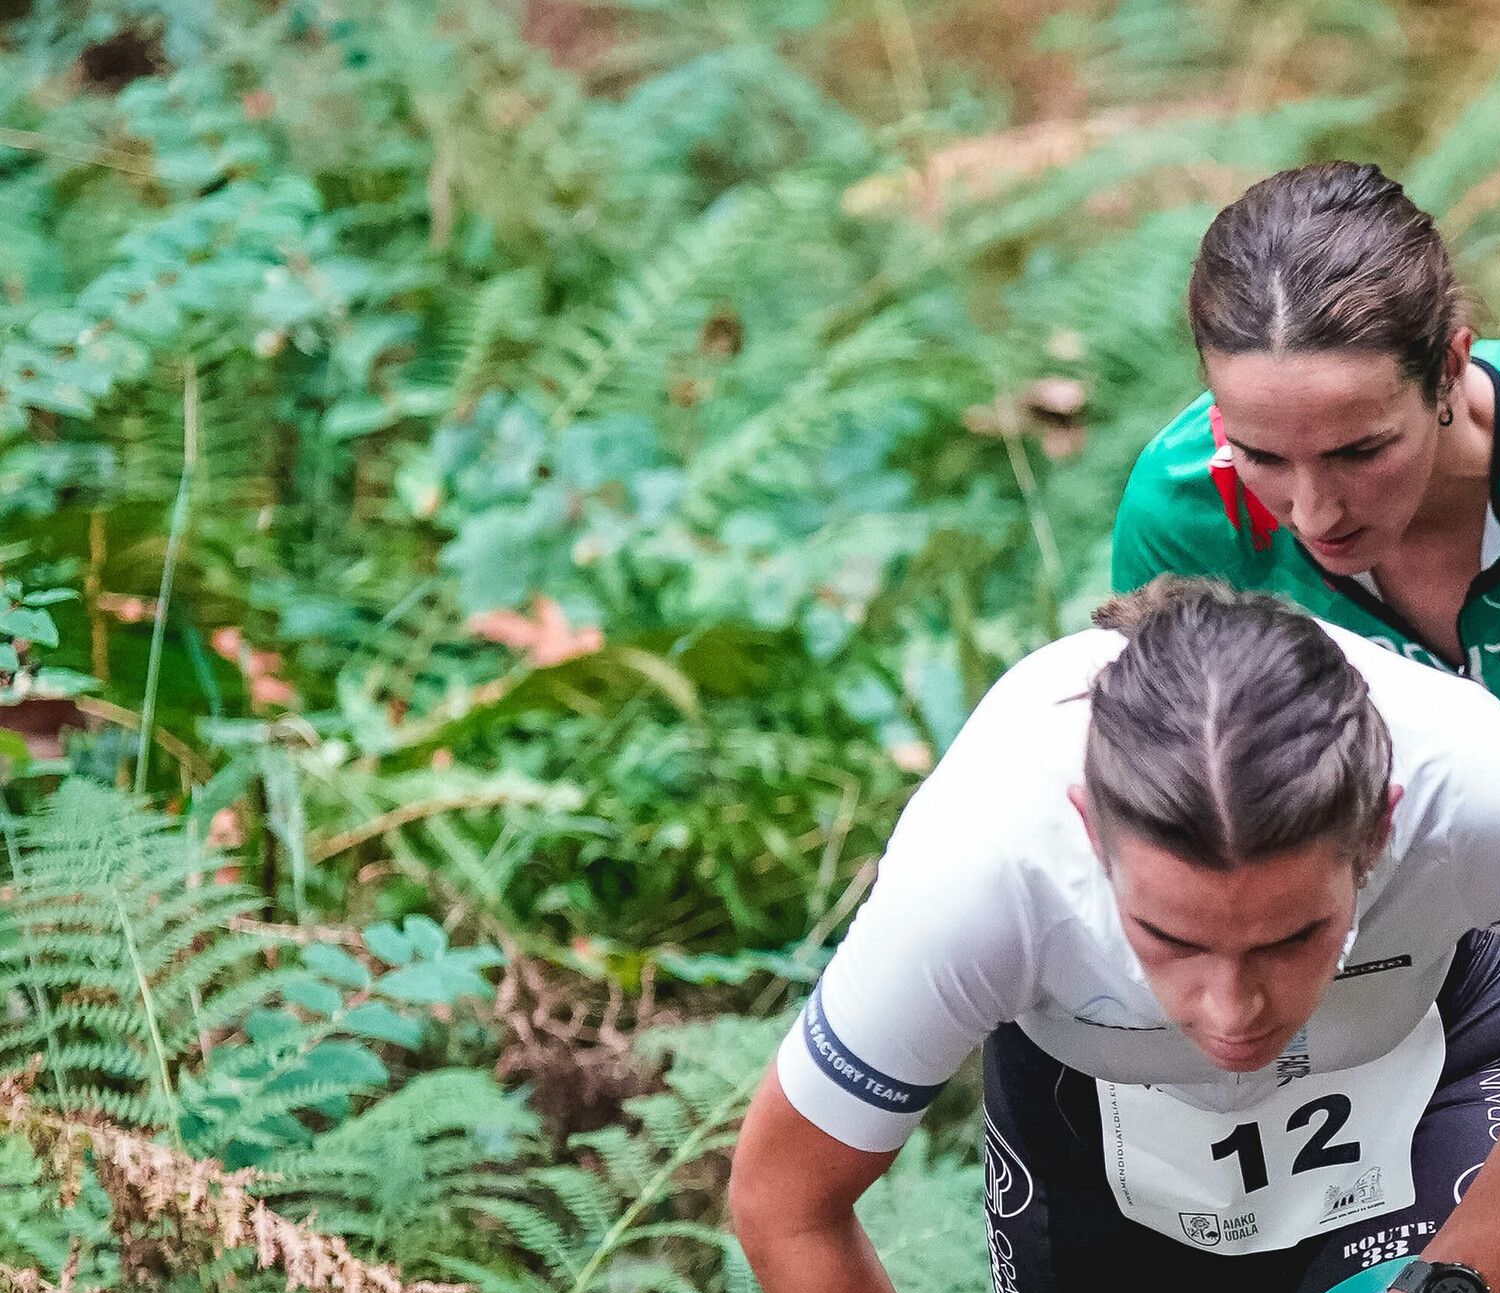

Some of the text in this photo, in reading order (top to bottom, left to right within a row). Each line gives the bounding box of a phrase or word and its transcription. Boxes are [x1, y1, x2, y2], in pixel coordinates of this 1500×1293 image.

[808, 1023, 911, 1104] FACTORY TEAM
[1210, 1093, 1362, 1194] 12
[1223, 1212, 1256, 1230] AIAKO
[1224, 1224, 1259, 1241] UDALA
[1343, 1221, 1437, 1259] ROUTE
[1361, 1240, 1409, 1268] 33
